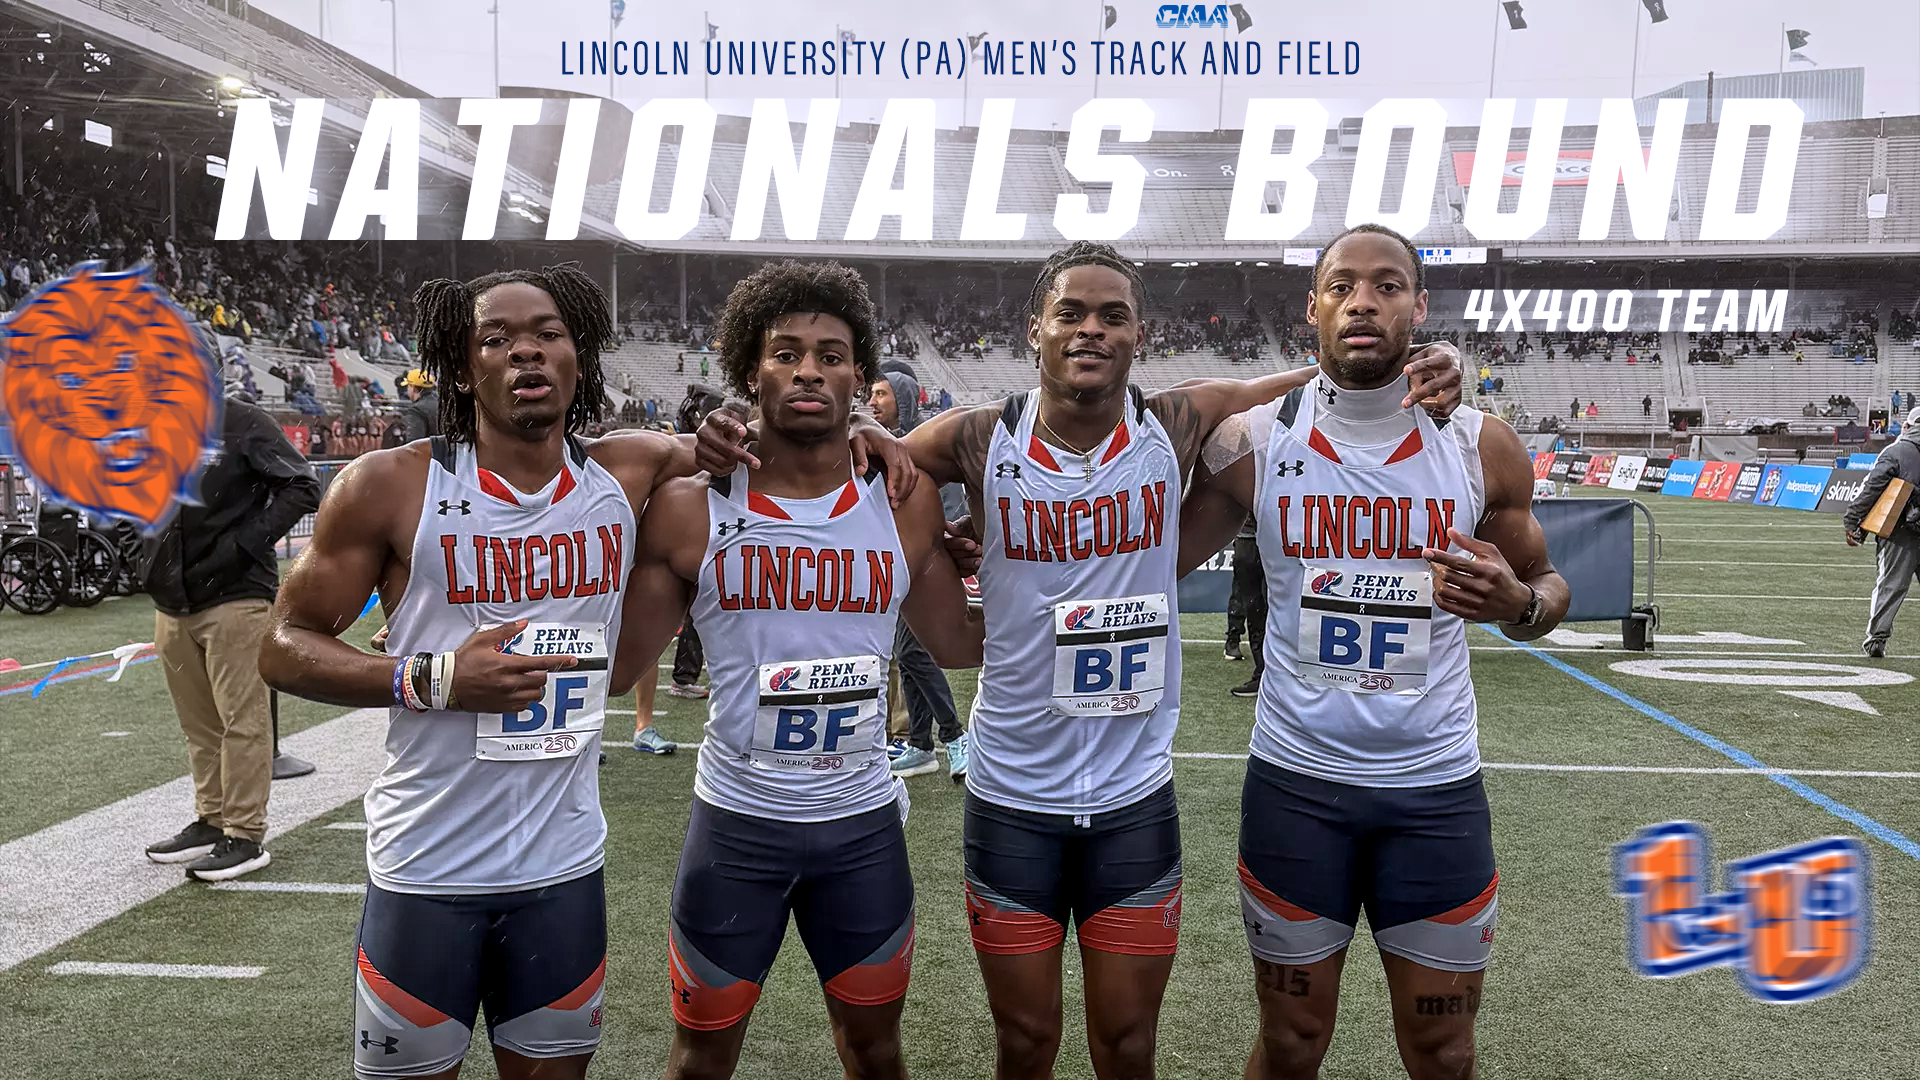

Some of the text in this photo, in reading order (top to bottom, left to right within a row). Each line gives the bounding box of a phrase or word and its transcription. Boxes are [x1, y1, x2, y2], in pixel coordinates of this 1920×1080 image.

[1786, 479, 1816, 494] Independence
[998, 481, 1166, 562] LINCOLN
[1278, 495, 1455, 559] LINCOLN
[440, 524, 622, 604] LINCOLN
[715, 545, 893, 614] LINCOLN
[1352, 574, 1404, 588] PENN
[1350, 586, 1417, 601] RELAYS
[1103, 601, 1145, 616] PENN
[1101, 611, 1157, 628] RELAYS
[535, 629, 580, 641] PENN
[1319, 615, 1409, 670] BF
[532, 642, 593, 655] RELAYS
[810, 662, 856, 677] PENN
[1073, 642, 1149, 693] BF
[808, 674, 868, 690] RELAYS
[1321, 672, 1358, 684] AMERICA
[502, 676, 588, 733] BF
[1075, 701, 1110, 709] AMERICA
[773, 705, 859, 752] BF
[504, 742, 543, 751] AMERICA
[774, 758, 811, 767] AMERICA
